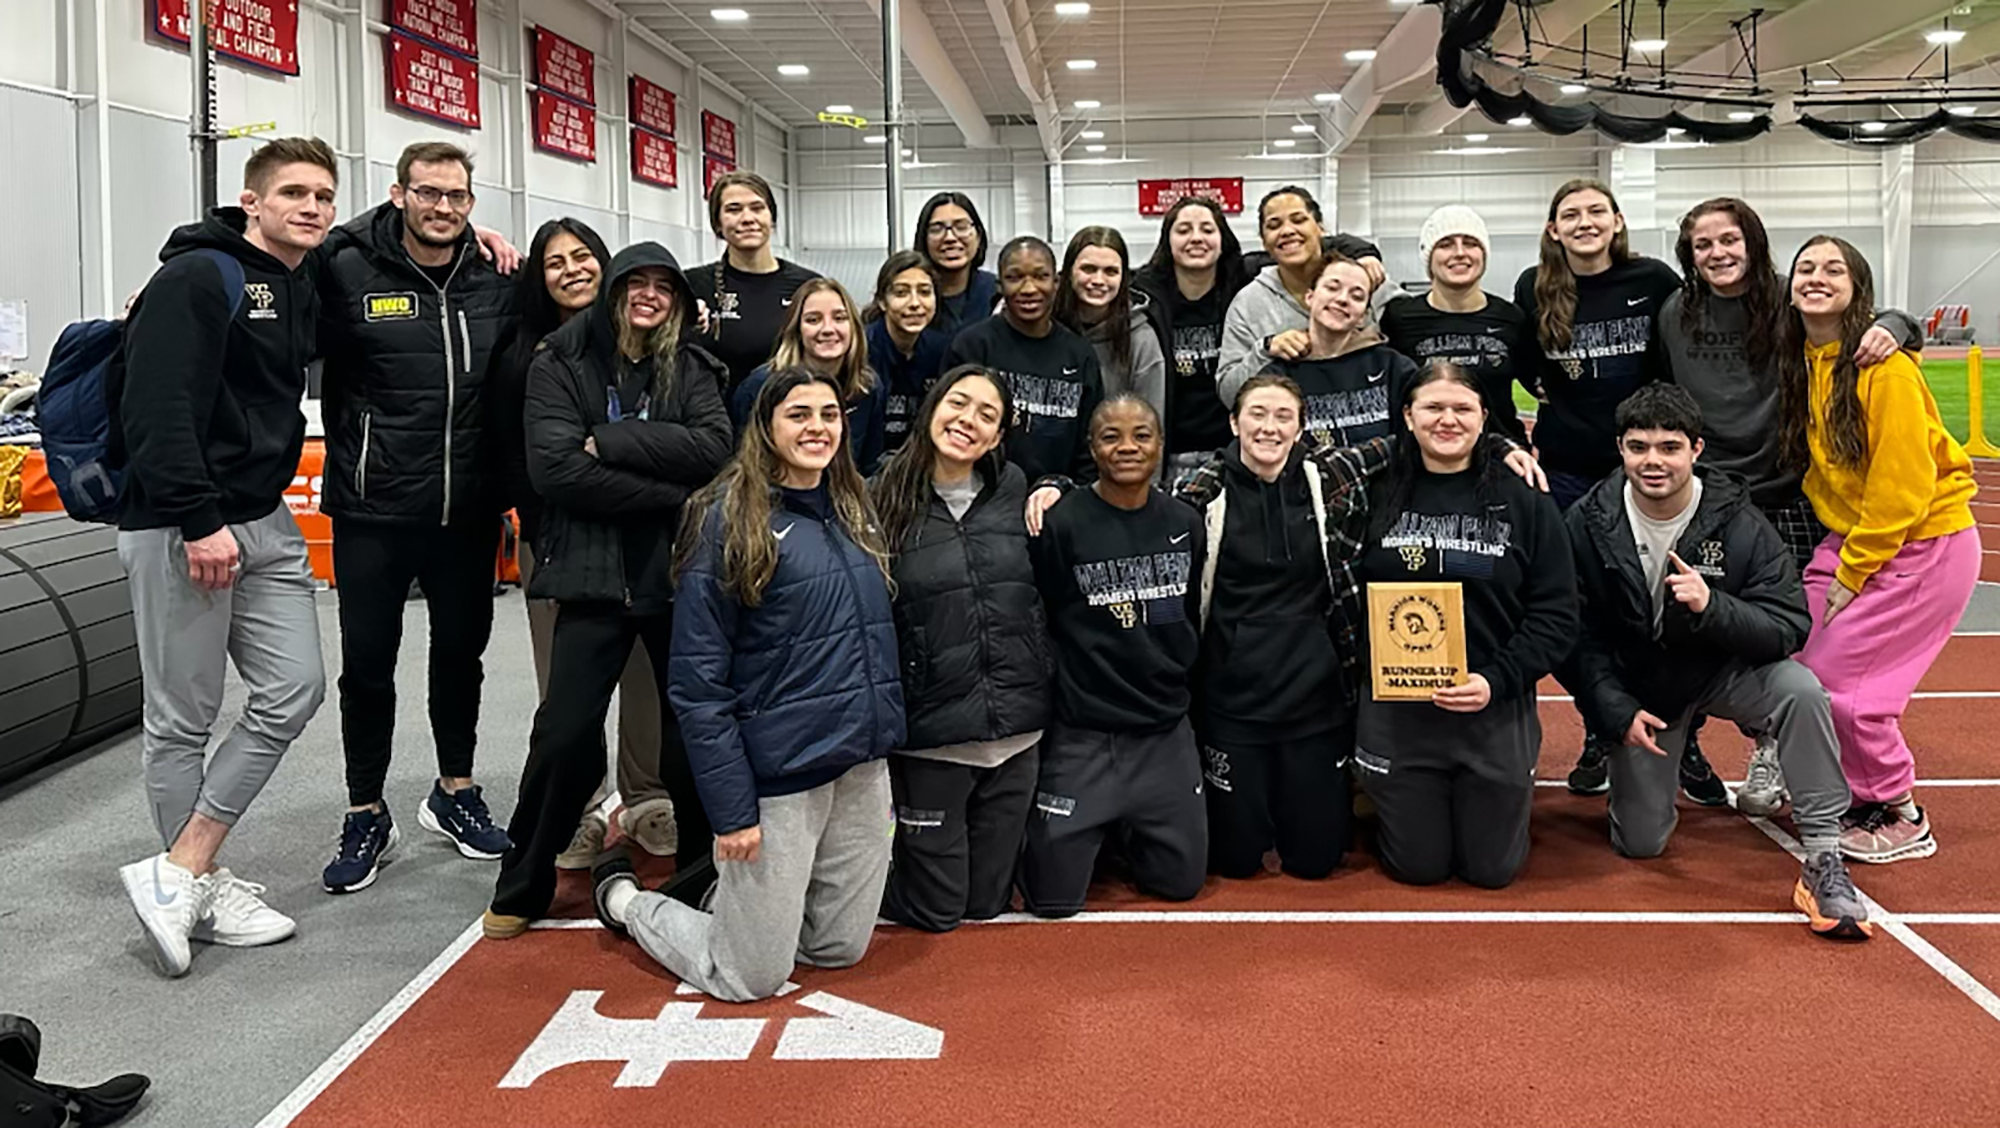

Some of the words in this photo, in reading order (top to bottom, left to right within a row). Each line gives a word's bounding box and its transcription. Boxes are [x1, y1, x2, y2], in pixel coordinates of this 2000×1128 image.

[225, 0, 272, 24] OUTDOOR
[223, 11, 244, 33] AND
[247, 20, 276, 44] FIELD
[234, 33, 282, 65] CHAMPION
[1588, 341, 1648, 358] WRESTLING
[1381, 536, 1434, 549] WOMEN'S
[1436, 536, 1506, 558] WRESTLING
[1403, 642, 1433, 654] OPEN
[1381, 665, 1459, 677] RUNNER-UP
